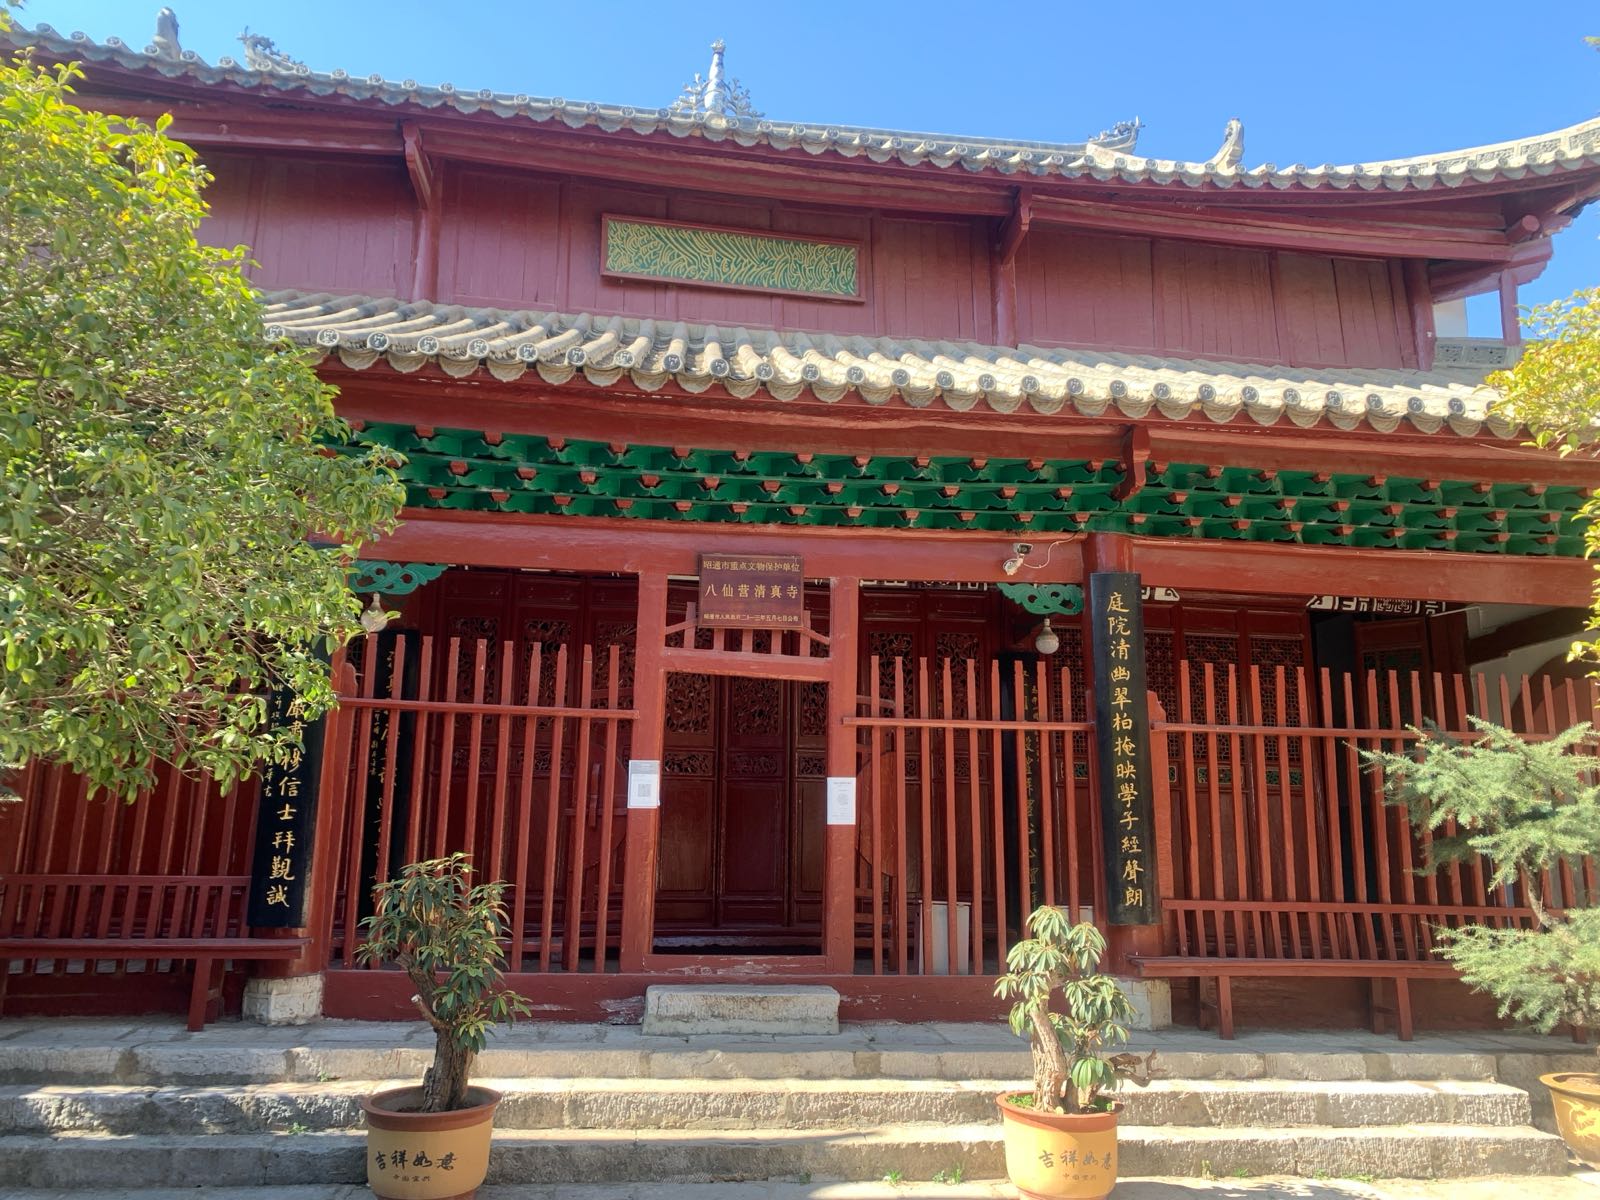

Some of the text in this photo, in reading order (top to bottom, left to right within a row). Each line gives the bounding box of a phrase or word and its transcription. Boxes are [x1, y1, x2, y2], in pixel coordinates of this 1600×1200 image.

[703, 560, 800, 572] 昭通市重点文物保护单位
[705, 583, 798, 599] 八仙营清真寺
[376, 1149, 456, 1171] 吉祥如意
[1039, 1149, 1112, 1170] 吉祥如意
